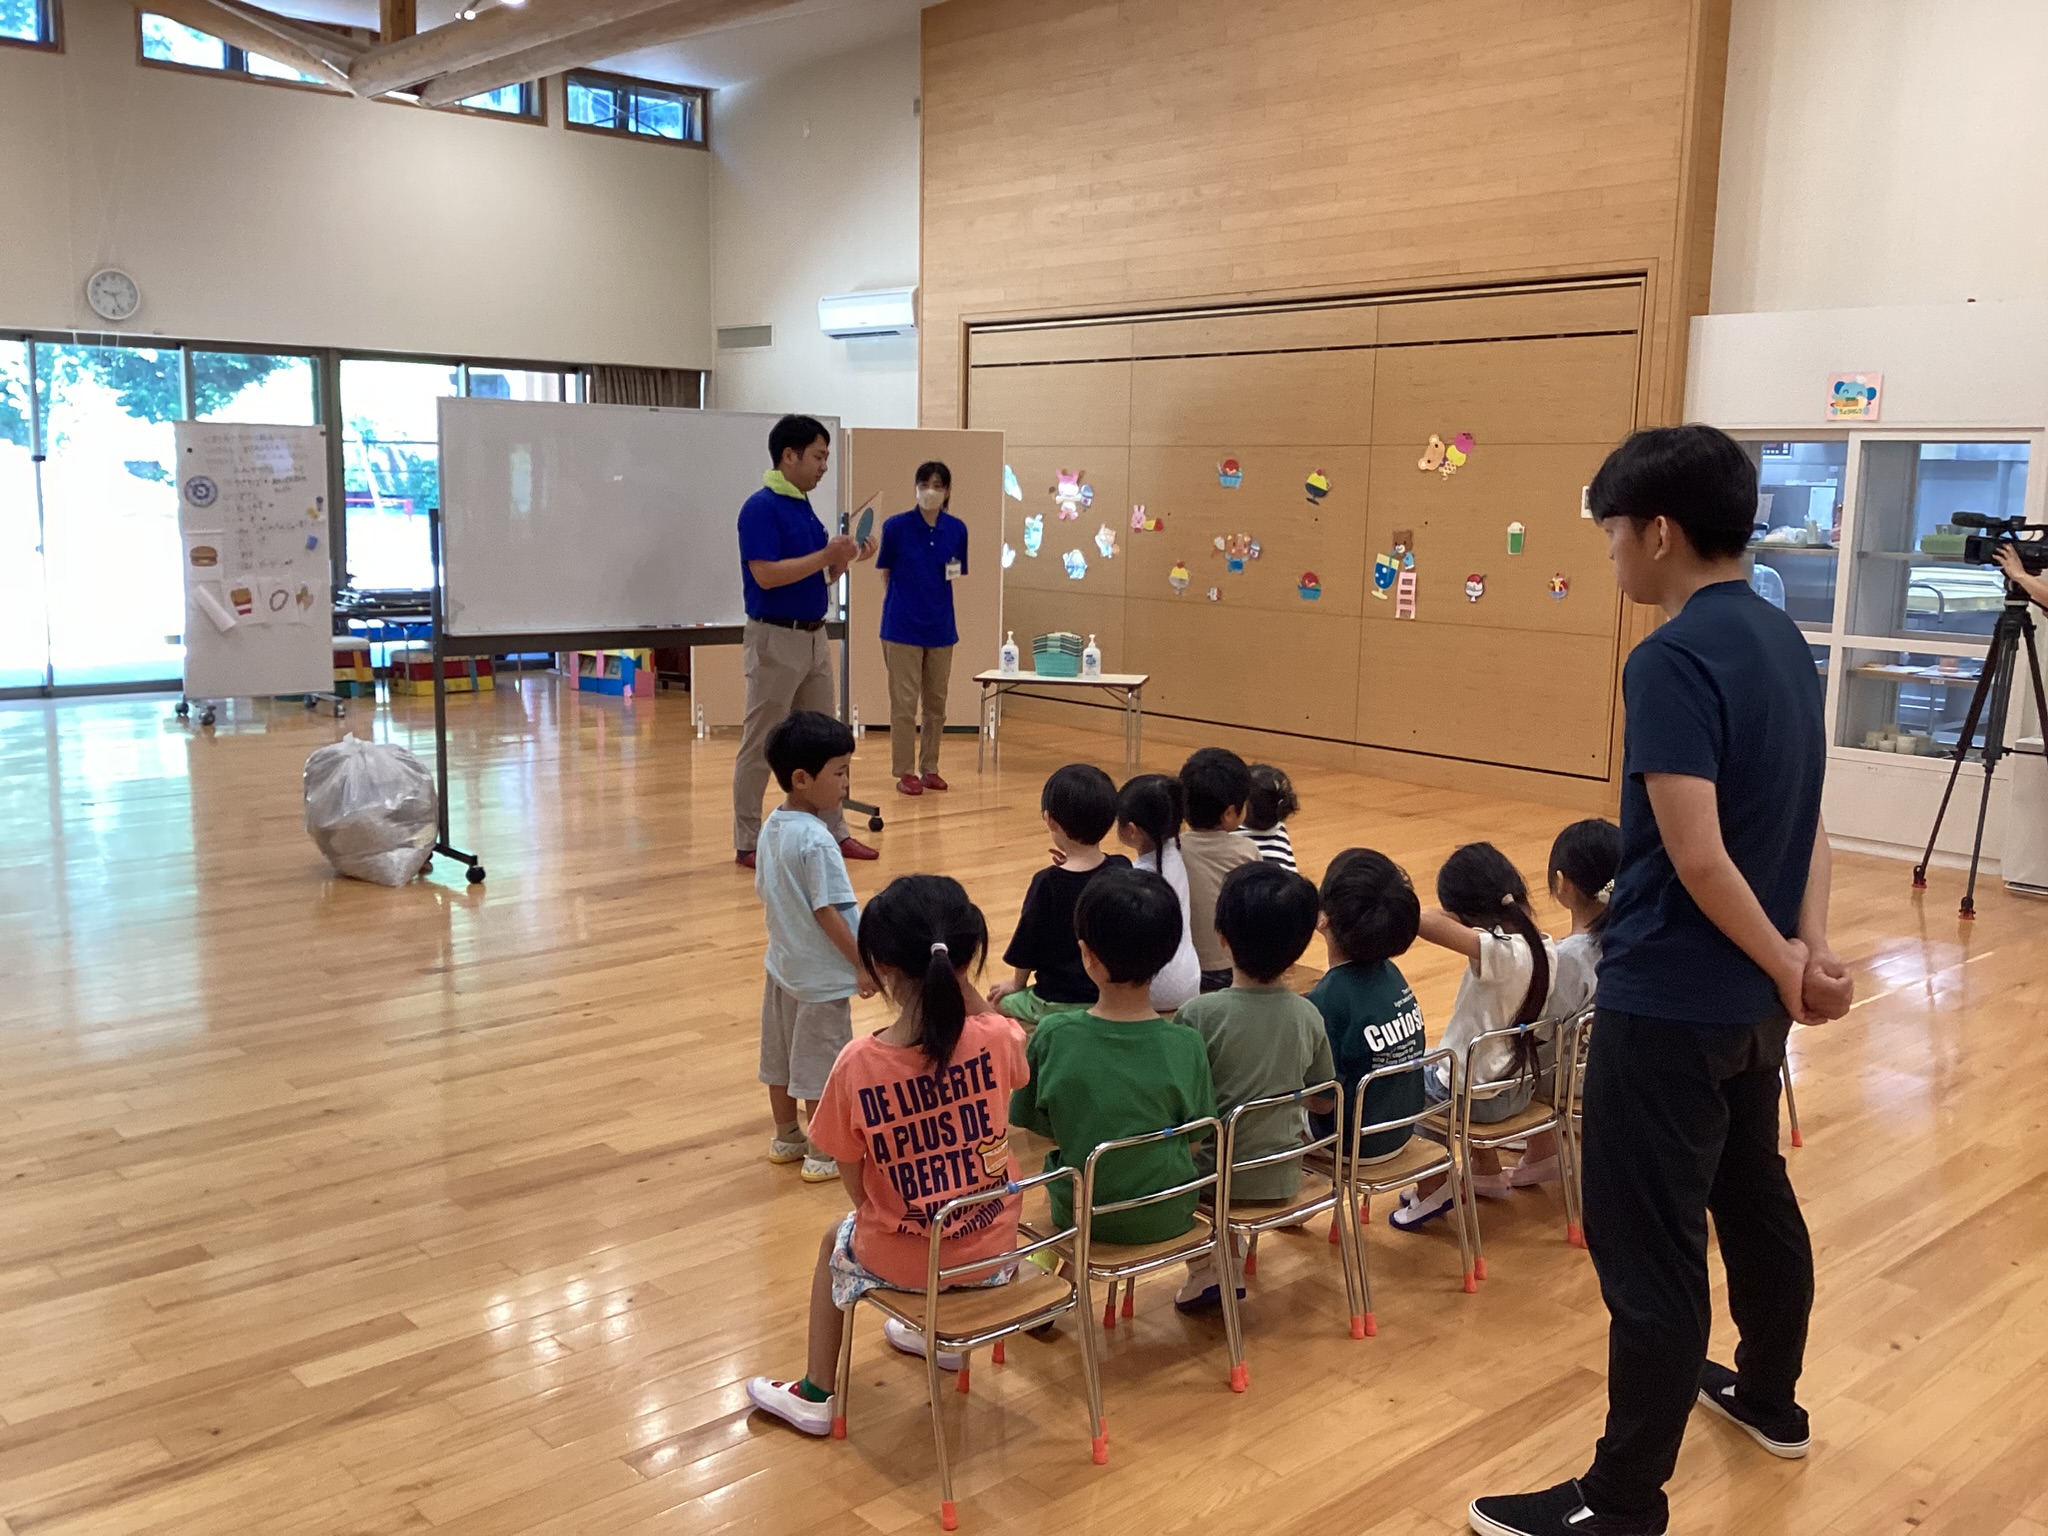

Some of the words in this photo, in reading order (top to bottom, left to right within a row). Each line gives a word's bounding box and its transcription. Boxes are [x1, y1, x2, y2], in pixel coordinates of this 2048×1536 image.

[858, 1085, 895, 1128] DE
[893, 1047, 997, 1118] LIBERTÉ
[872, 1131, 892, 1165] A
[892, 1111, 957, 1158] PLUS
[958, 1099, 993, 1142] DE
[879, 1143, 979, 1201] IBERTÉ
